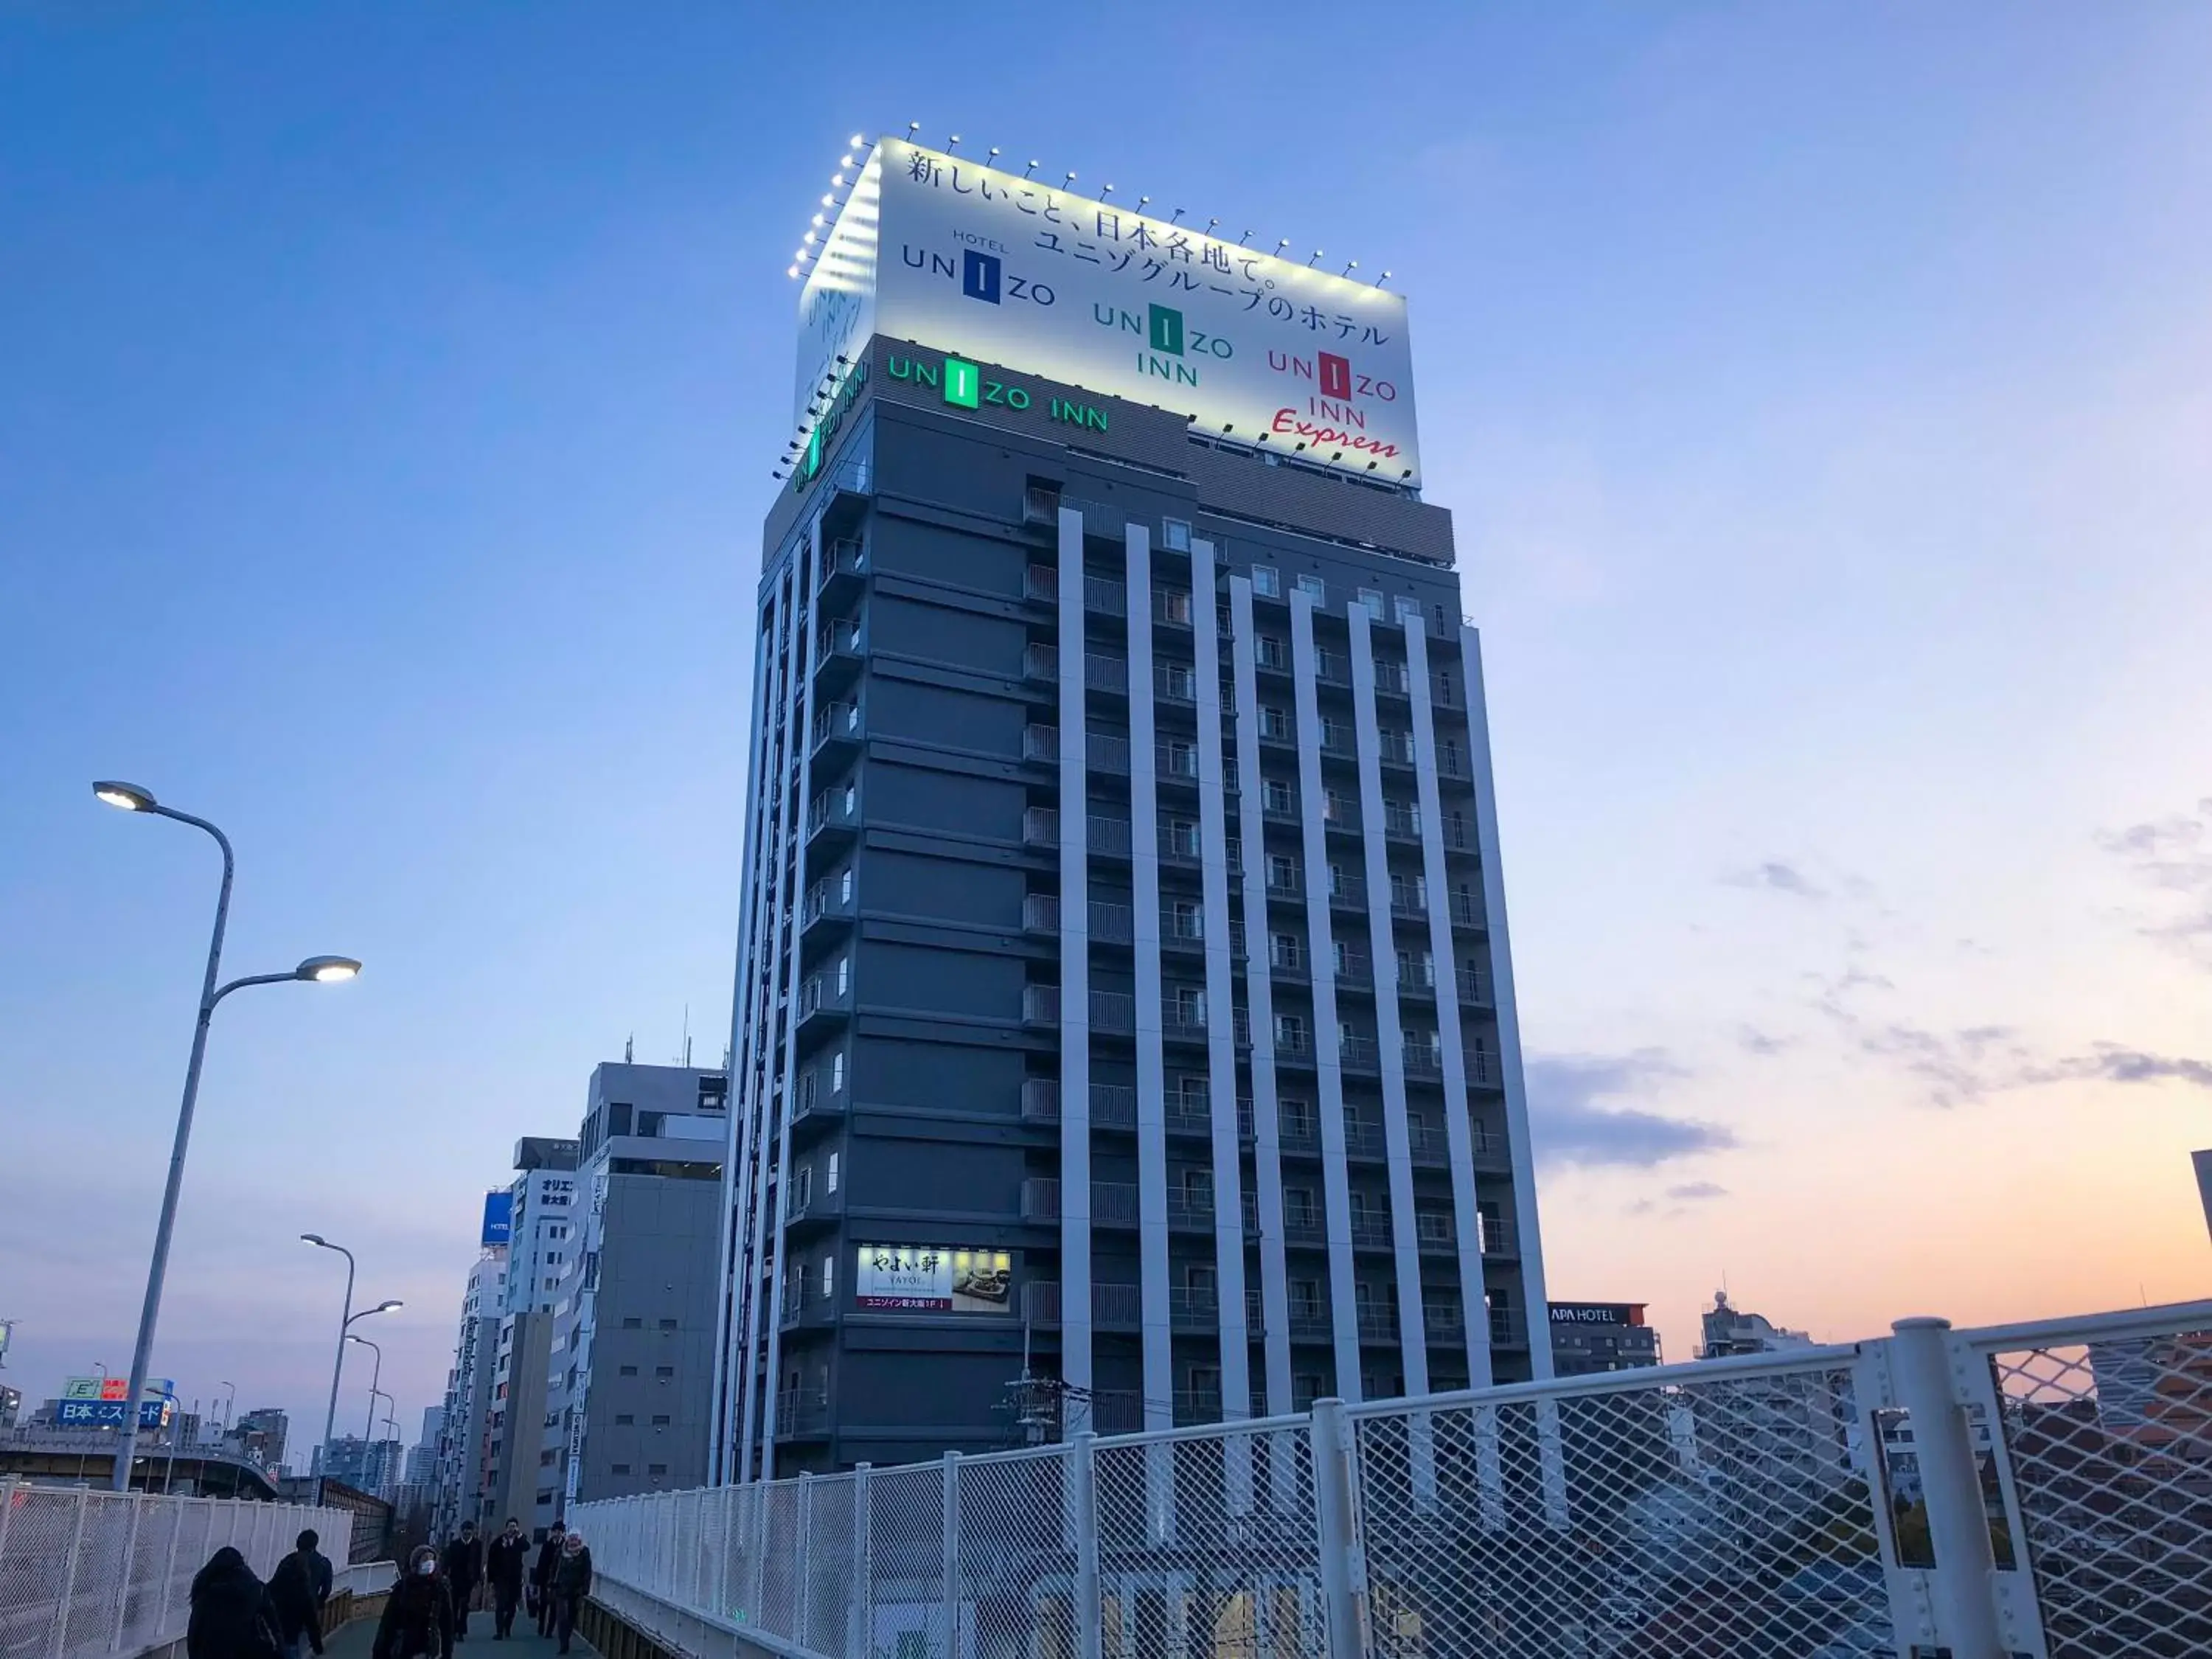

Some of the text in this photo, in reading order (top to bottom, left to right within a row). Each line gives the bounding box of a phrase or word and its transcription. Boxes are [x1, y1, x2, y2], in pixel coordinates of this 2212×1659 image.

[953, 229, 1010, 254] HOTEL
[902, 244, 1055, 306] UNIZO
[1034, 231, 1390, 346] ユニゾグループのホテル
[1094, 303, 1234, 359] UNIZO
[889, 355, 1107, 432] UNIZO INN
[1138, 352, 1197, 387] INN
[1269, 350, 1396, 402] UNIZO
[1272, 408, 1399, 458] Express
[1310, 397, 1365, 429] INN
[872, 1254, 939, 1274] やよい軒
[1551, 1309, 1615, 1322] APA HOTEL
